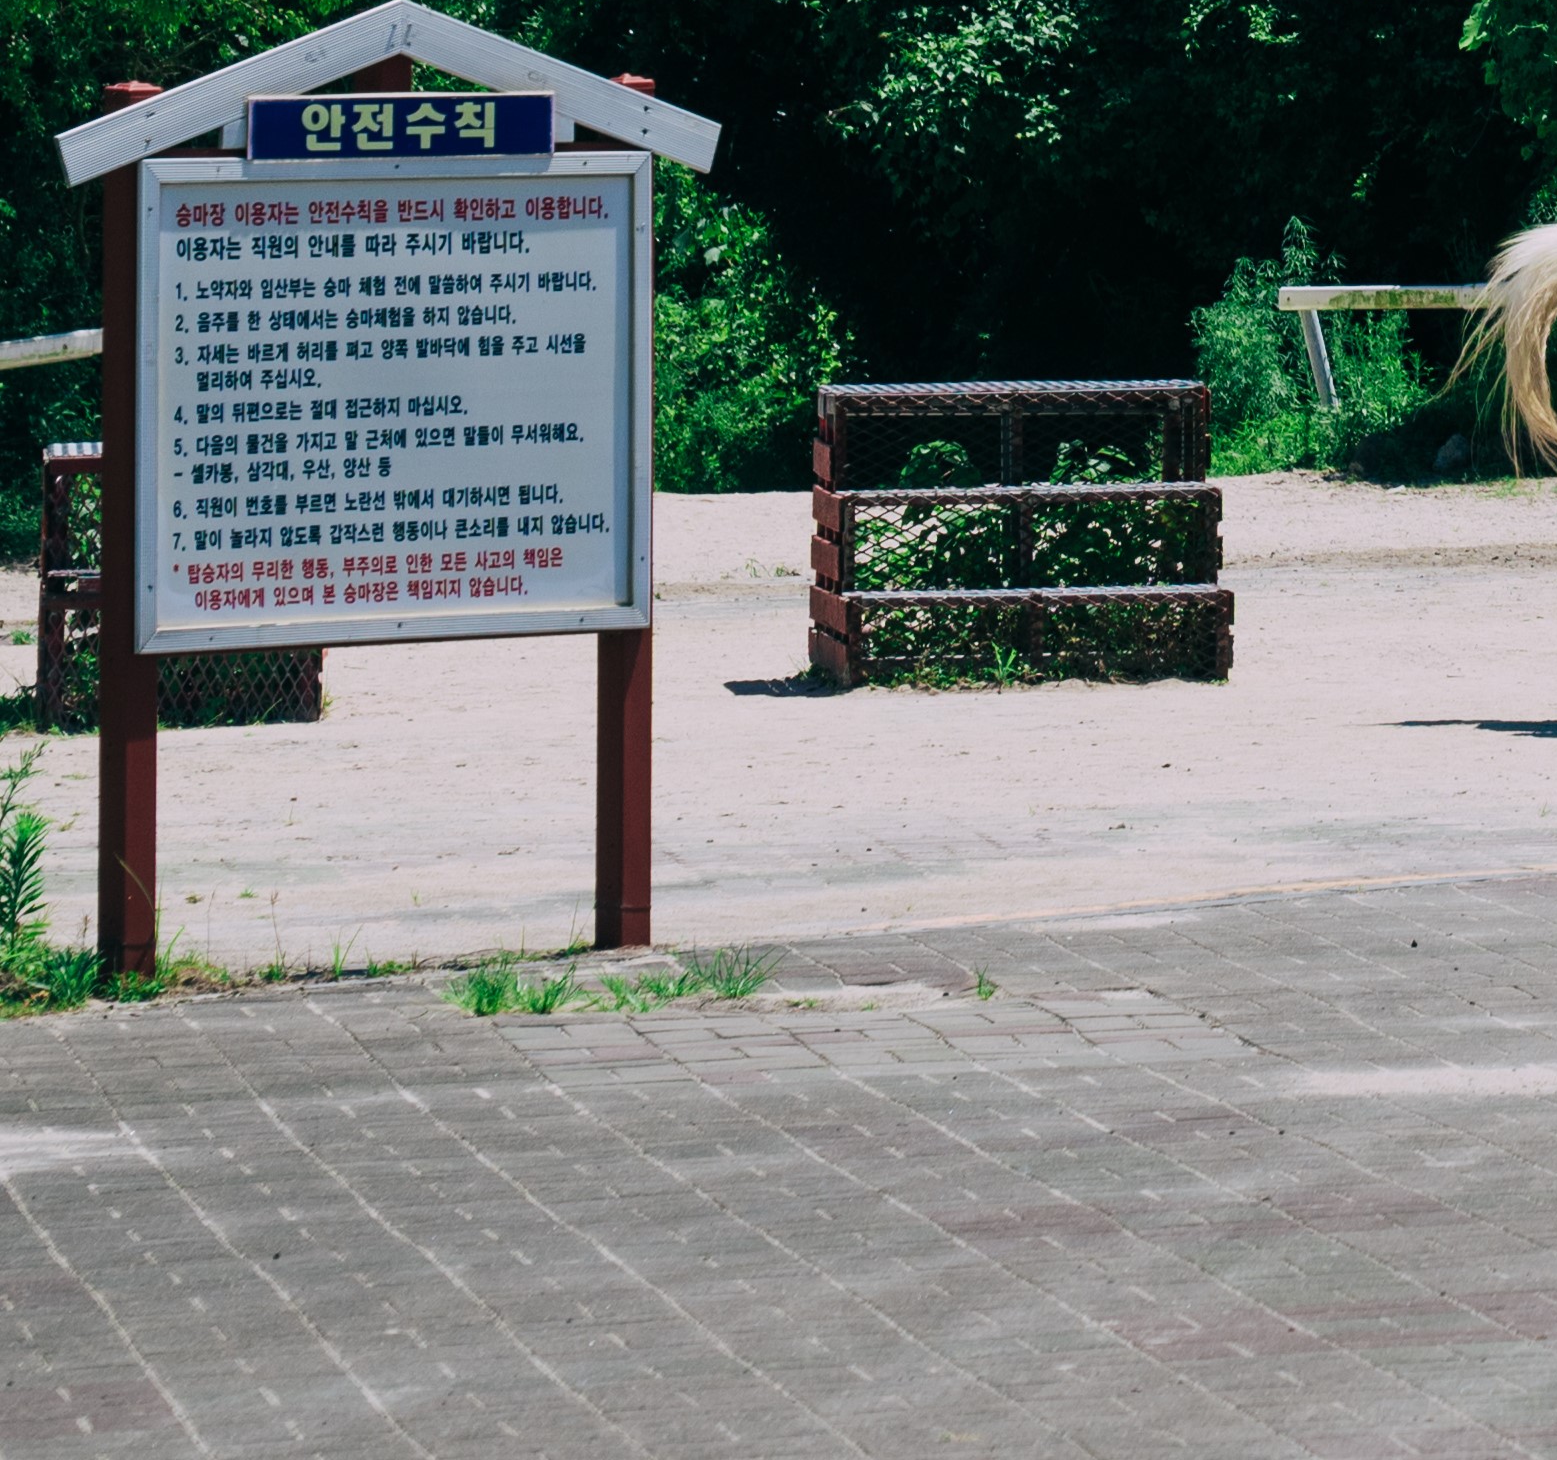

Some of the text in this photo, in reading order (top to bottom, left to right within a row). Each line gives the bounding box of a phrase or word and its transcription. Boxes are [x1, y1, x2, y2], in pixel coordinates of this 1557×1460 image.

[301, 102, 495, 151] 안전수칙
[176, 196, 608, 227] 승마장 이용자는 안전수칙을 반드시 확인하고 이용합니다.
[177, 231, 530, 261] 이용자는 직원의 안내를 따라 주시기 바랍니다.
[196, 279, 252, 300] 노약자와
[261, 278, 316, 298] 임산부는
[324, 277, 350, 297] 승마
[359, 276, 386, 296] 체험
[395, 275, 420, 295] 전에
[429, 274, 482, 294] 말씀하여
[490, 272, 529, 293] 주시기
[538, 271, 596, 291] 바랍니다.
[198, 311, 238, 332] 음주를
[248, 310, 261, 330] 한
[269, 308, 338, 330] 상태에서는
[346, 308, 414, 328] 승마체험을
[423, 307, 449, 326] 하지
[458, 305, 515, 325] 않습니다.
[198, 344, 239, 365] 자세는
[248, 342, 288, 363] 바르게
[297, 341, 337, 361] 허리를
[346, 340, 373, 360] 펴고
[382, 338, 408, 360] 양쪽
[416, 337, 469, 358] 발바닥에
[478, 336, 504, 356] 힘을
[512, 336, 538, 355] 주고
[546, 333, 586, 354] 시선을
[197, 368, 321, 391] 멀리하여 주십시오.
[197, 404, 223, 424] 말의
[233, 401, 302, 422] 뒤편으로는
[311, 400, 337, 419] 절대
[345, 398, 399, 418] 접근하지
[408, 396, 468, 415] 마십시오.
[197, 435, 237, 456] 다음의
[246, 433, 288, 454] 물건을
[296, 432, 337, 452] 가지고
[345, 431, 357, 450] 말
[366, 429, 407, 449] 근처에
[415, 427, 455, 447] 있으면
[464, 425, 503, 446] 말들이
[511, 423, 584, 444] 무서워해요.
[343, 457, 370, 477] 양산
[378, 456, 391, 477] 등
[196, 497, 237, 518] 직원이
[246, 495, 287, 516] 번호를
[295, 493, 336, 513] 부르면
[345, 491, 385, 511] 노란선
[394, 489, 434, 510] 밖에서
[443, 486, 510, 507] 대기하시면
[518, 484, 563, 504] 됩니다.
[194, 529, 221, 550] 말이
[230, 527, 272, 548] 놀라지
[280, 526, 321, 547] 않도록
[330, 523, 384, 544] 갑작스런
[393, 520, 447, 542] 행동이나
[455, 517, 509, 538] 큰소리를
[517, 516, 543, 535] 내지
[551, 513, 609, 534] 않습니다.
[188, 562, 243, 584] 탑승자의
[252, 560, 293, 580] 무리한
[343, 556, 398, 577] 부주의로
[406, 553, 432, 573] 인한
[441, 551, 467, 571] 모든
[475, 549, 515, 570] 사고의
[523, 547, 563, 568] 책임은
[195, 576, 528, 611] 이용자에게 있으며 본 승마장은 책임지지 않습니다.
